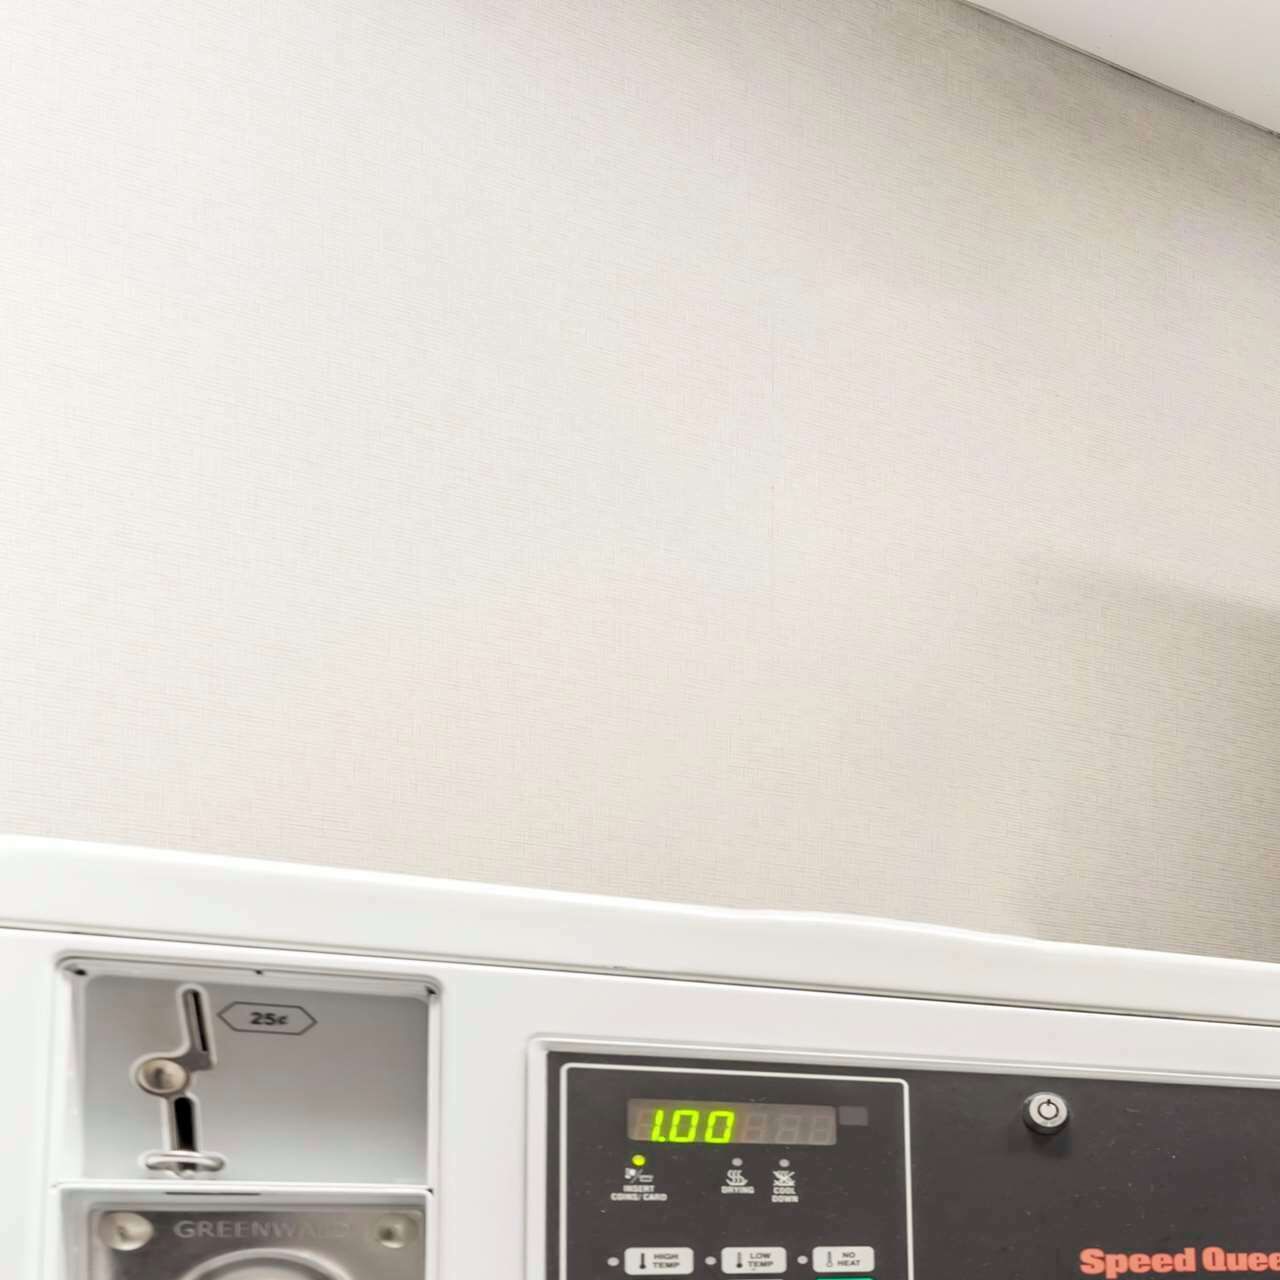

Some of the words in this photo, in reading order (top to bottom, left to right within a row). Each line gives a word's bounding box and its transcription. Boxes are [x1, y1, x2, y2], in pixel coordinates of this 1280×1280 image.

[250, 1011, 288, 1025] 25¢
[651, 1109, 736, 1143] 1.00
[173, 1220, 349, 1238] GREENWAD
[747, 1260, 774, 1268] TEMP
[1080, 1246, 1196, 1279] Speed
